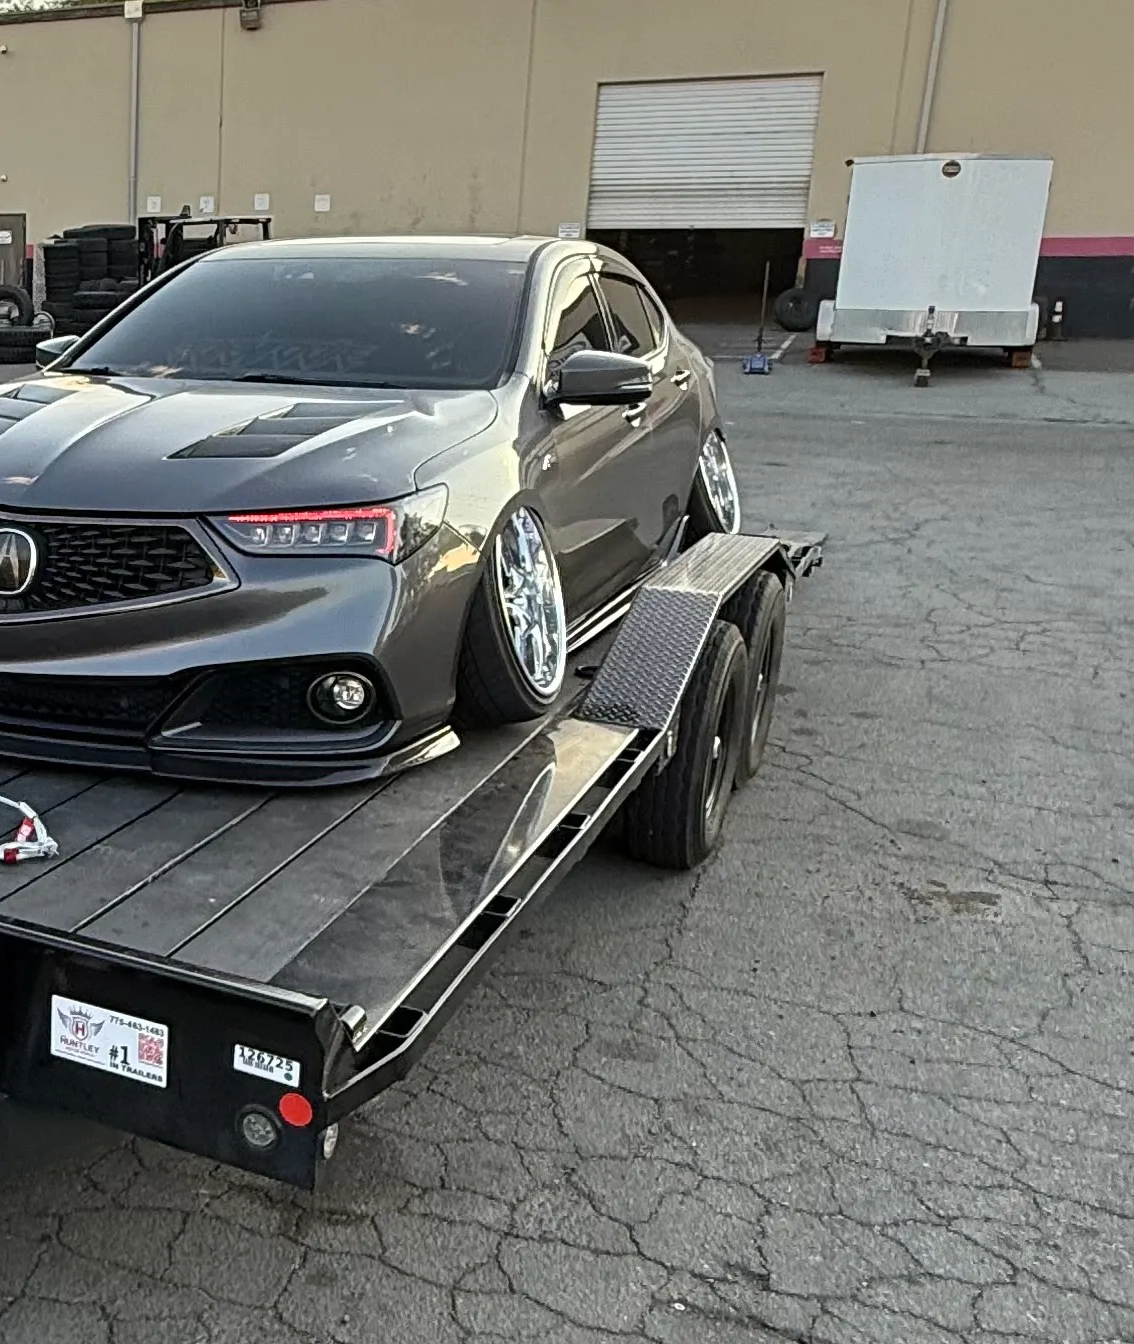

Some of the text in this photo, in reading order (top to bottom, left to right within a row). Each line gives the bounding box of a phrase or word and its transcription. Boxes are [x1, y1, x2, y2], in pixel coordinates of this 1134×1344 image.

[109, 1045, 130, 1065] #1
[239, 1046, 293, 1071] 126725
[109, 1061, 119, 1070] IN
[121, 1064, 163, 1082] TRAILERS
